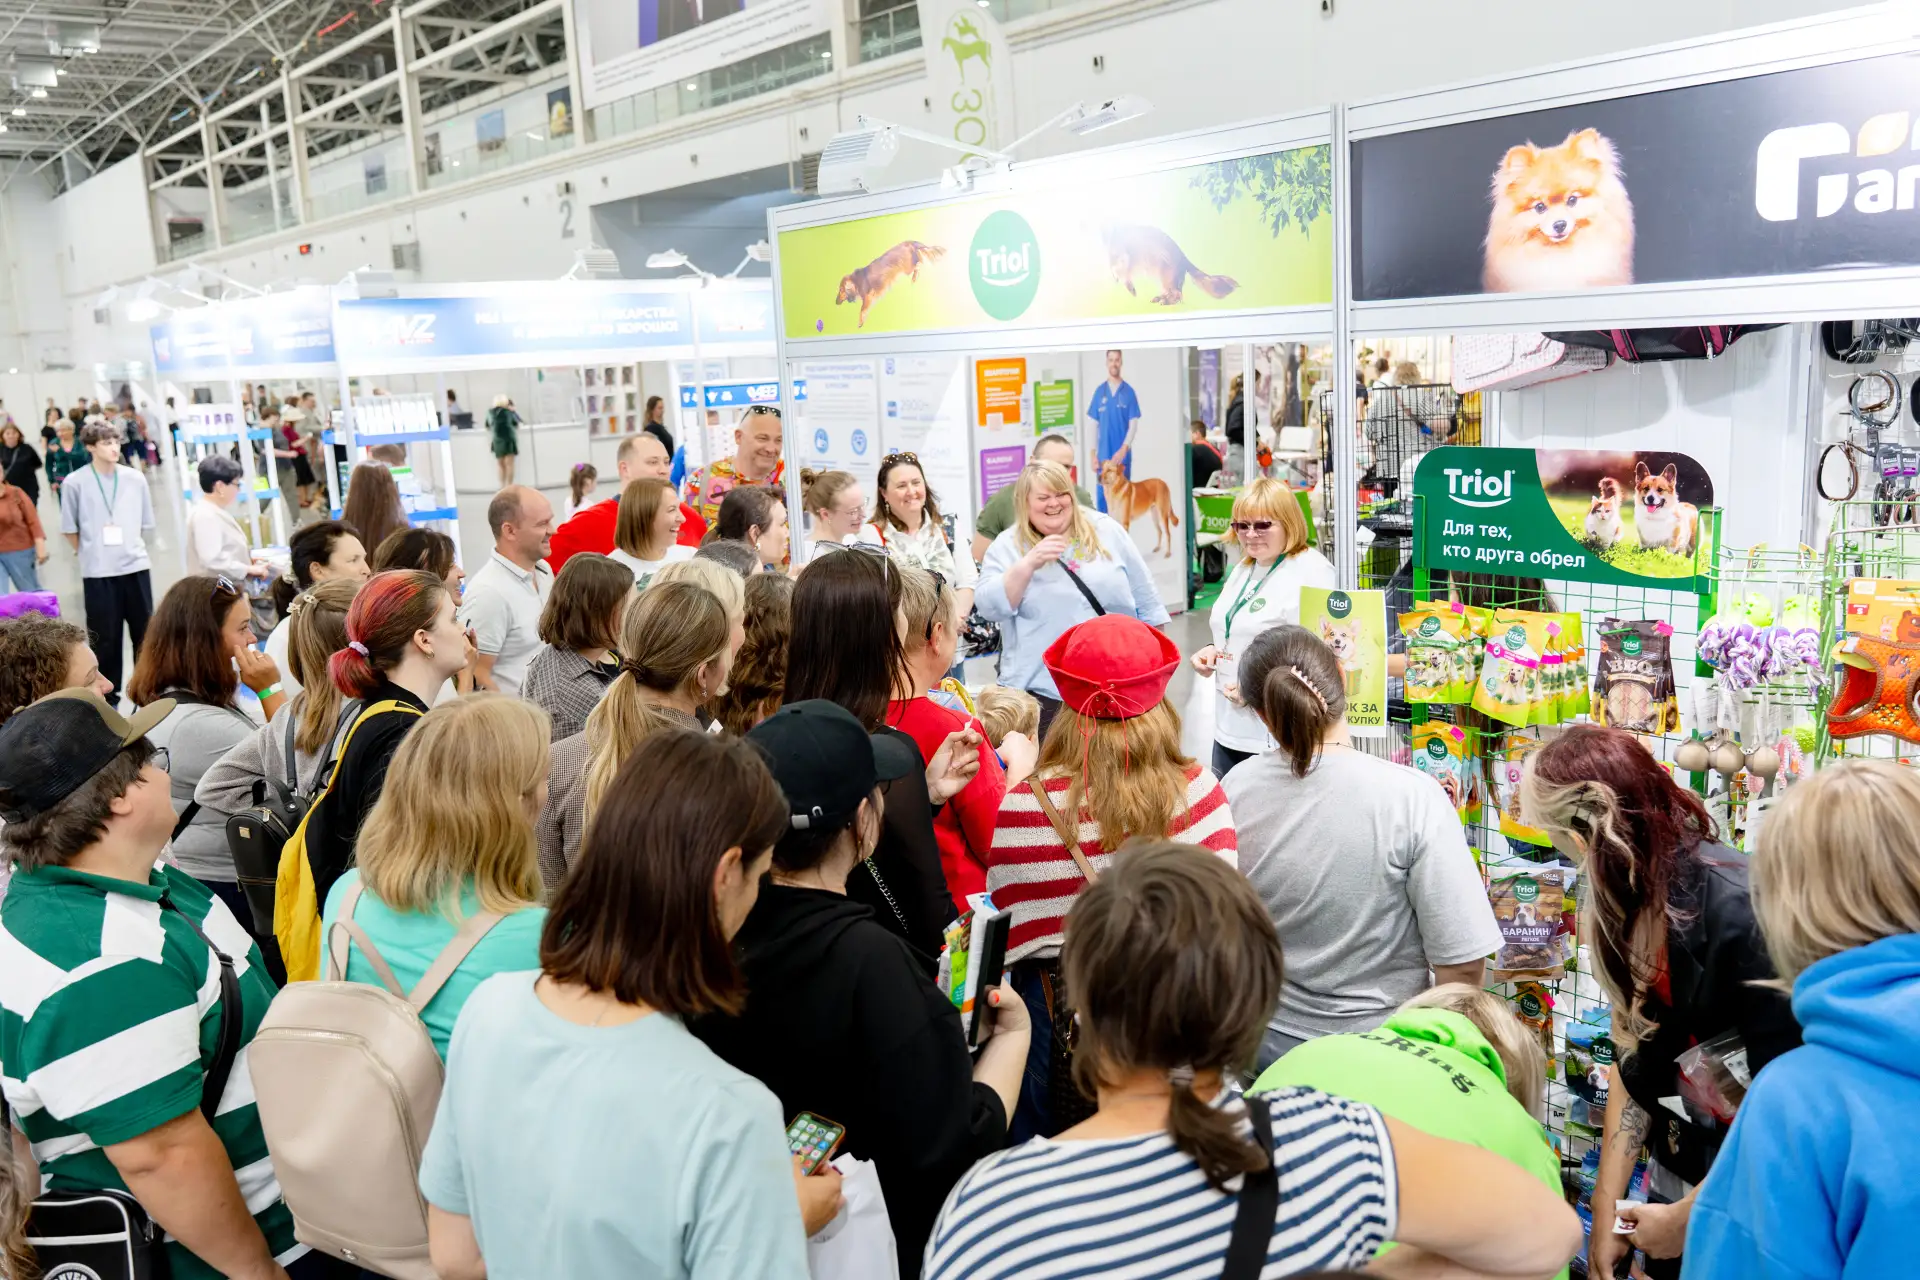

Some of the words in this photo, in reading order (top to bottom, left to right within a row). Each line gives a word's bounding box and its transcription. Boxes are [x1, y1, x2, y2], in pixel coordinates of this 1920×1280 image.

[559, 199, 576, 239] 2
[976, 242, 1031, 276] Triol
[1444, 468, 1516, 497] Triol
[1443, 519, 1474, 537] Для
[1478, 523, 1512, 541] тех,
[1443, 545, 1471, 558] кто
[1475, 547, 1524, 564] друга
[1530, 551, 1585, 569] обрел
[1329, 598, 1348, 608] Triol
[1361, 703, 1379, 714] ЗА
[1345, 715, 1381, 725] КУПКУ
[1428, 743, 1445, 753] Triol
[1516, 885, 1536, 894] Triol
[1593, 1045, 1613, 1056] Trio
